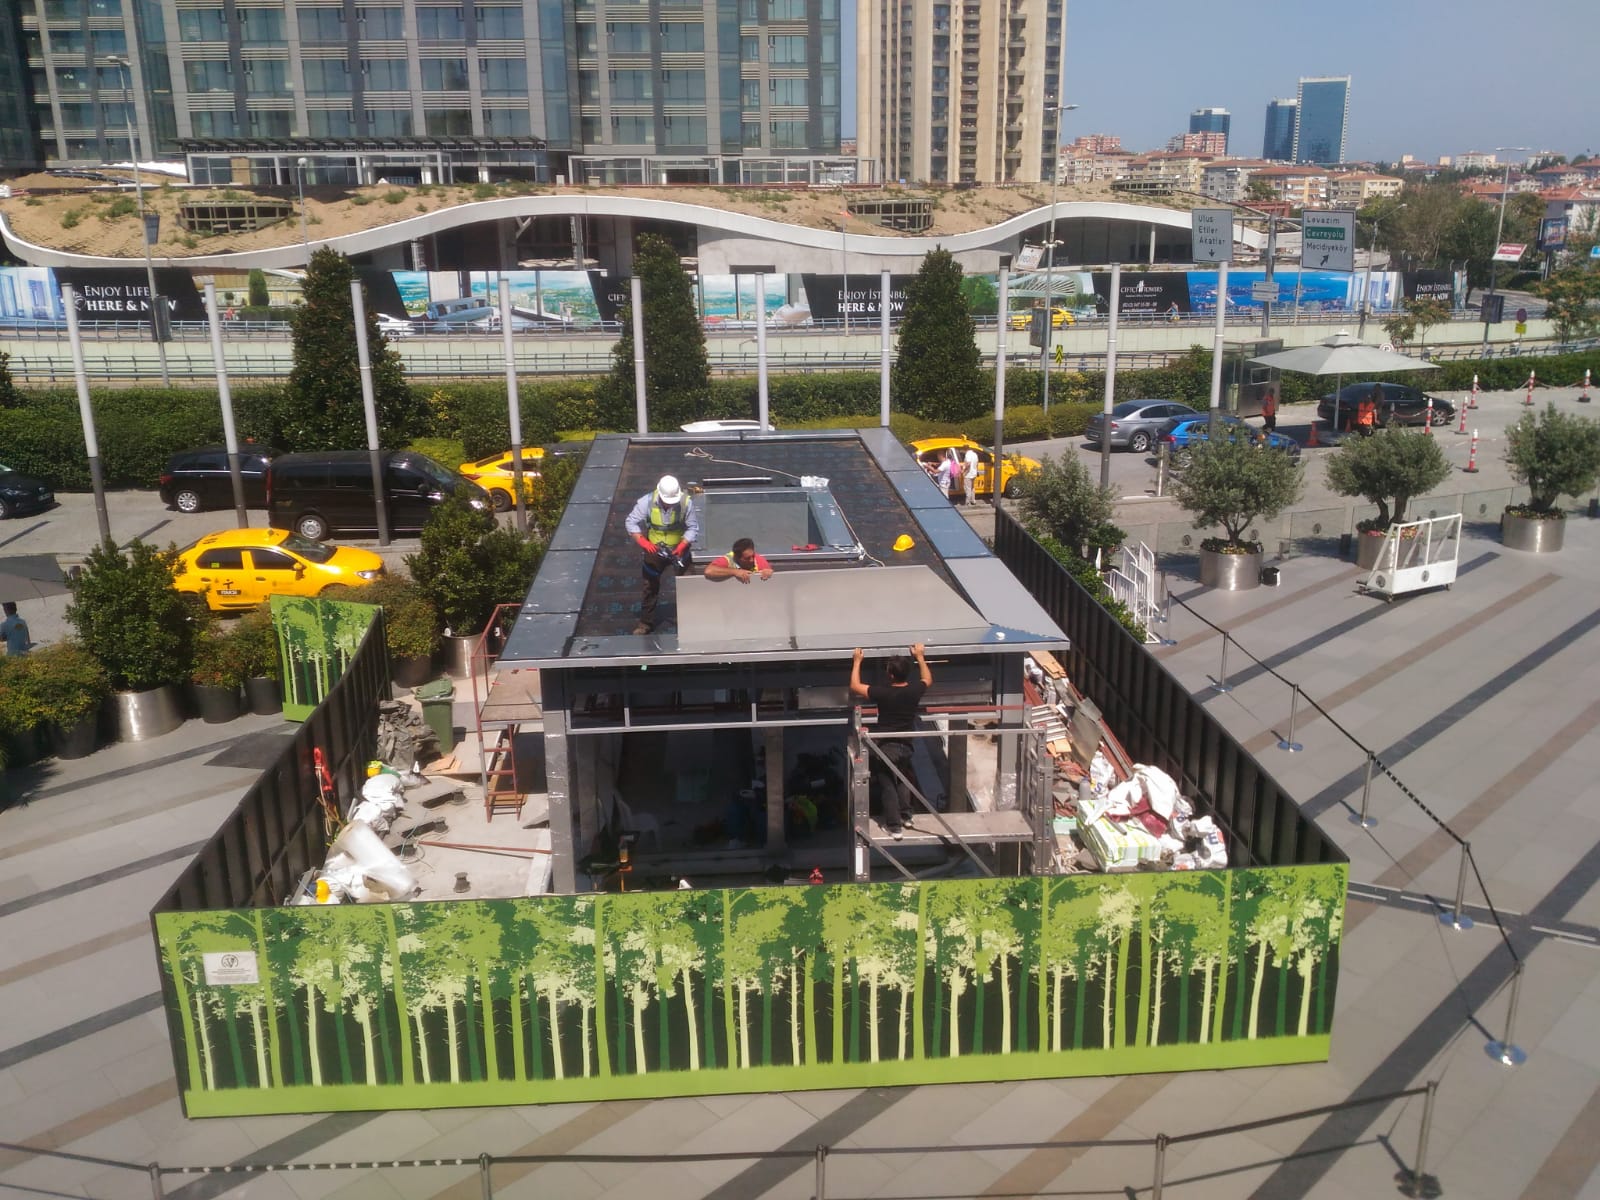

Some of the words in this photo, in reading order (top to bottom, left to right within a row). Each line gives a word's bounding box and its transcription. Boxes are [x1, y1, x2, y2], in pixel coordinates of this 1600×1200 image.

[84, 285, 121, 298] ENJOY
[87, 300, 123, 311] HERE
[126, 301, 138, 311] &
[141, 300, 177, 311] NW
[867, 302, 875, 312] &
